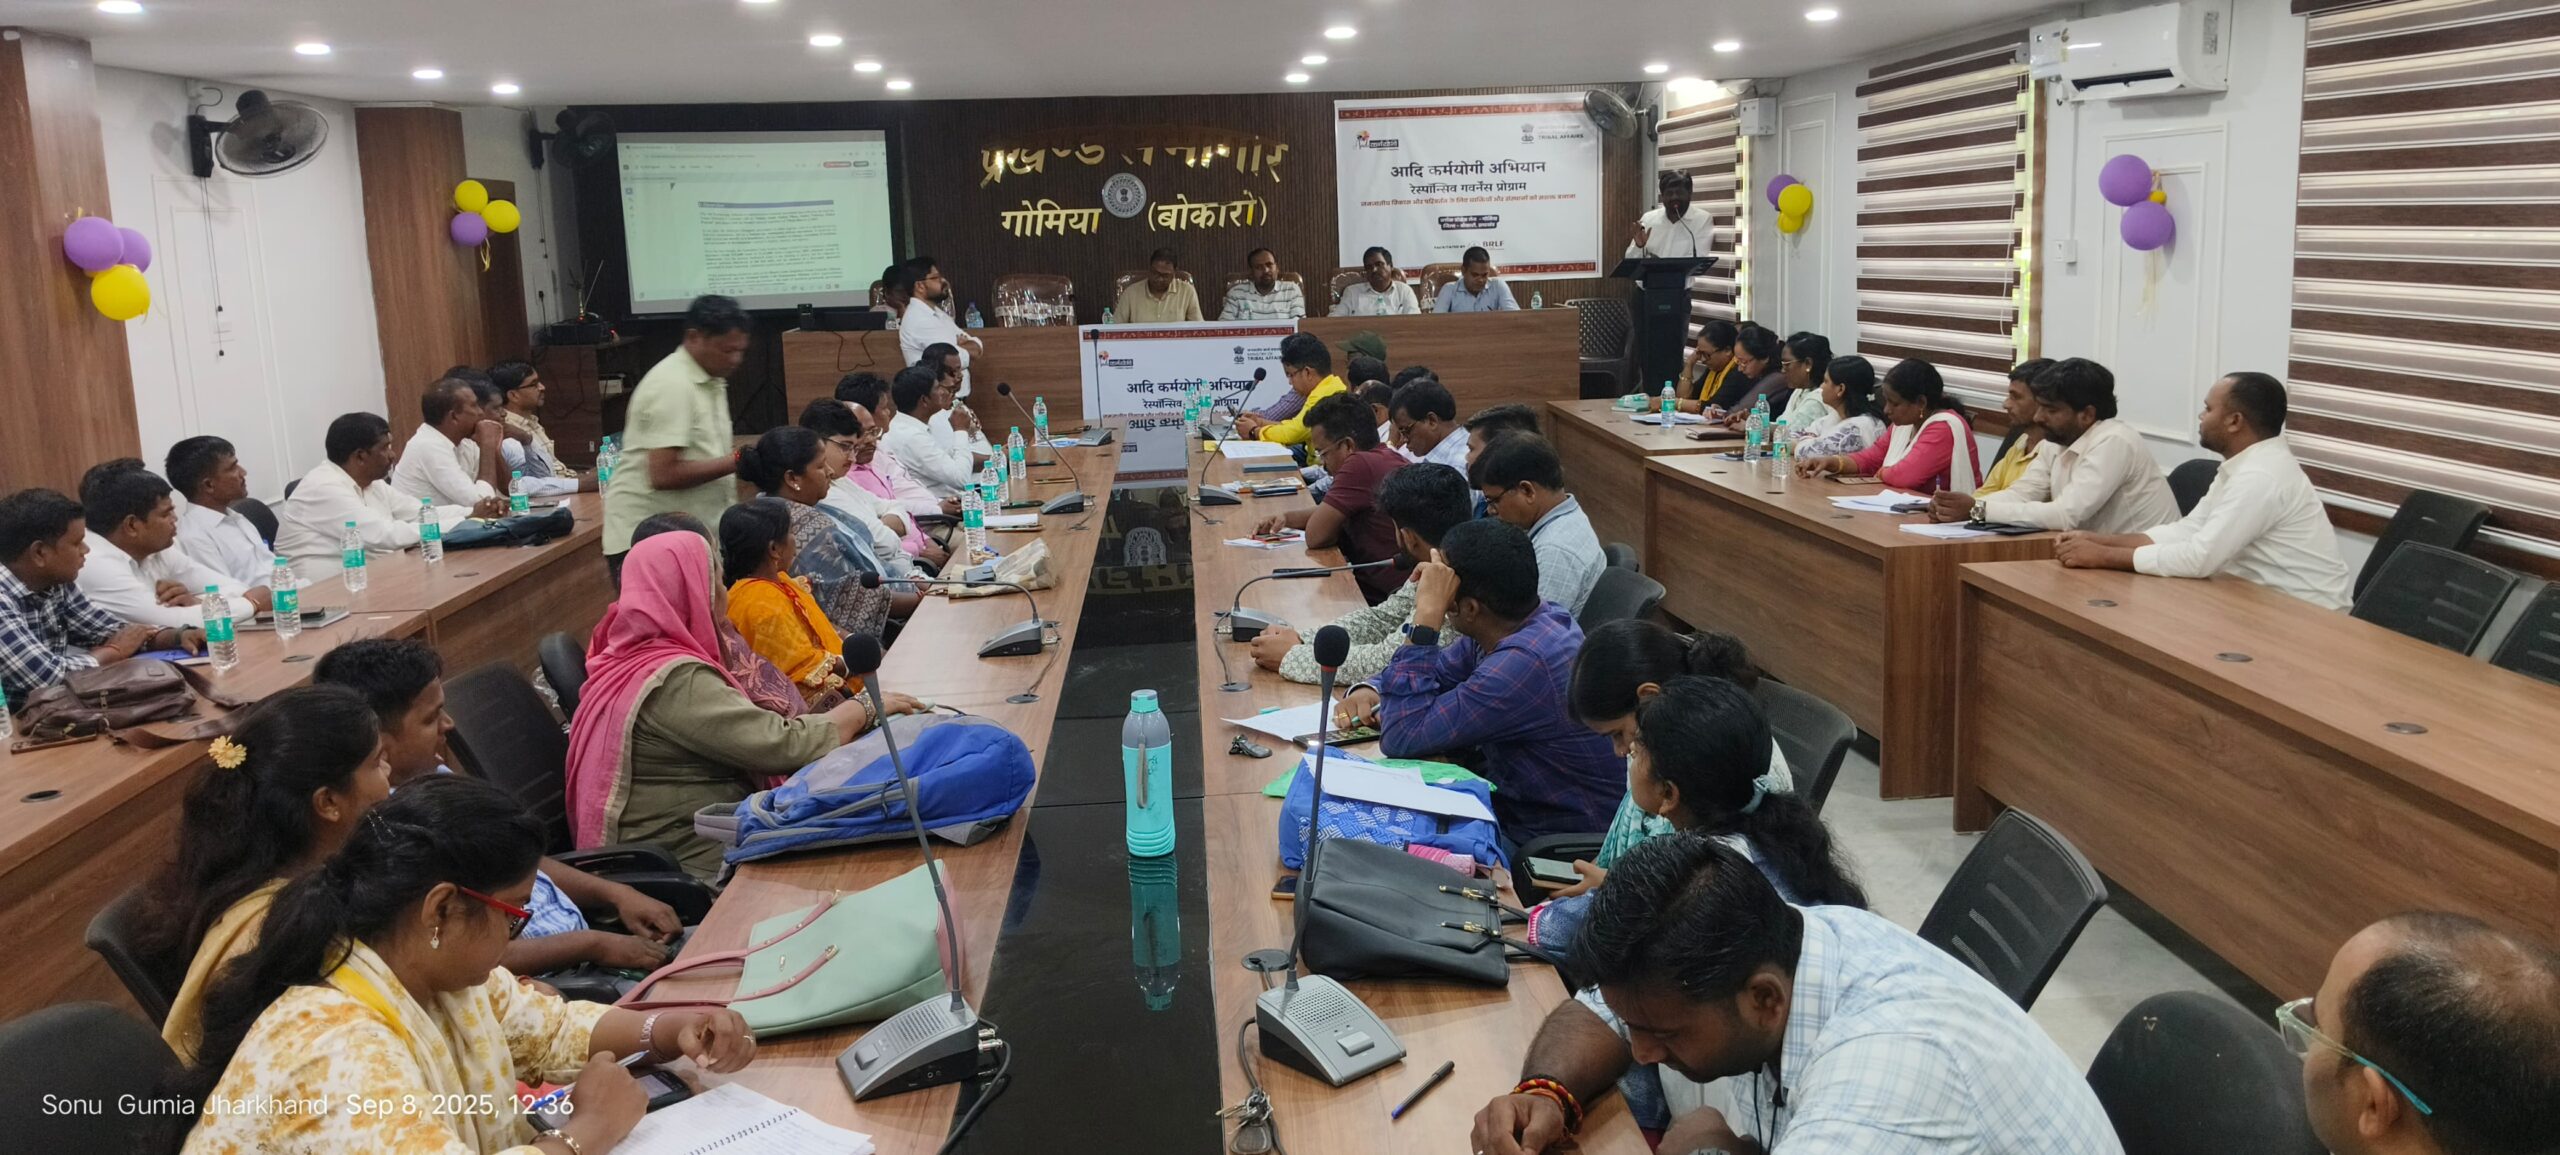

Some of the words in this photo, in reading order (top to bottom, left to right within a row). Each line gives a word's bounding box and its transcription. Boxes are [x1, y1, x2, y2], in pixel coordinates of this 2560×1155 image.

[1390, 161, 1424, 178] आदि
[1428, 160, 1485, 176] कर्मयोगी
[1489, 158, 1546, 174] अभियान
[1496, 179, 1527, 192] प्रोग्राम
[1001, 198, 1102, 238] गोमिया
[1147, 189, 1267, 232] (बोकारो)
[1127, 379, 1155, 394] आदि
[1209, 377, 1253, 391] अभिया
